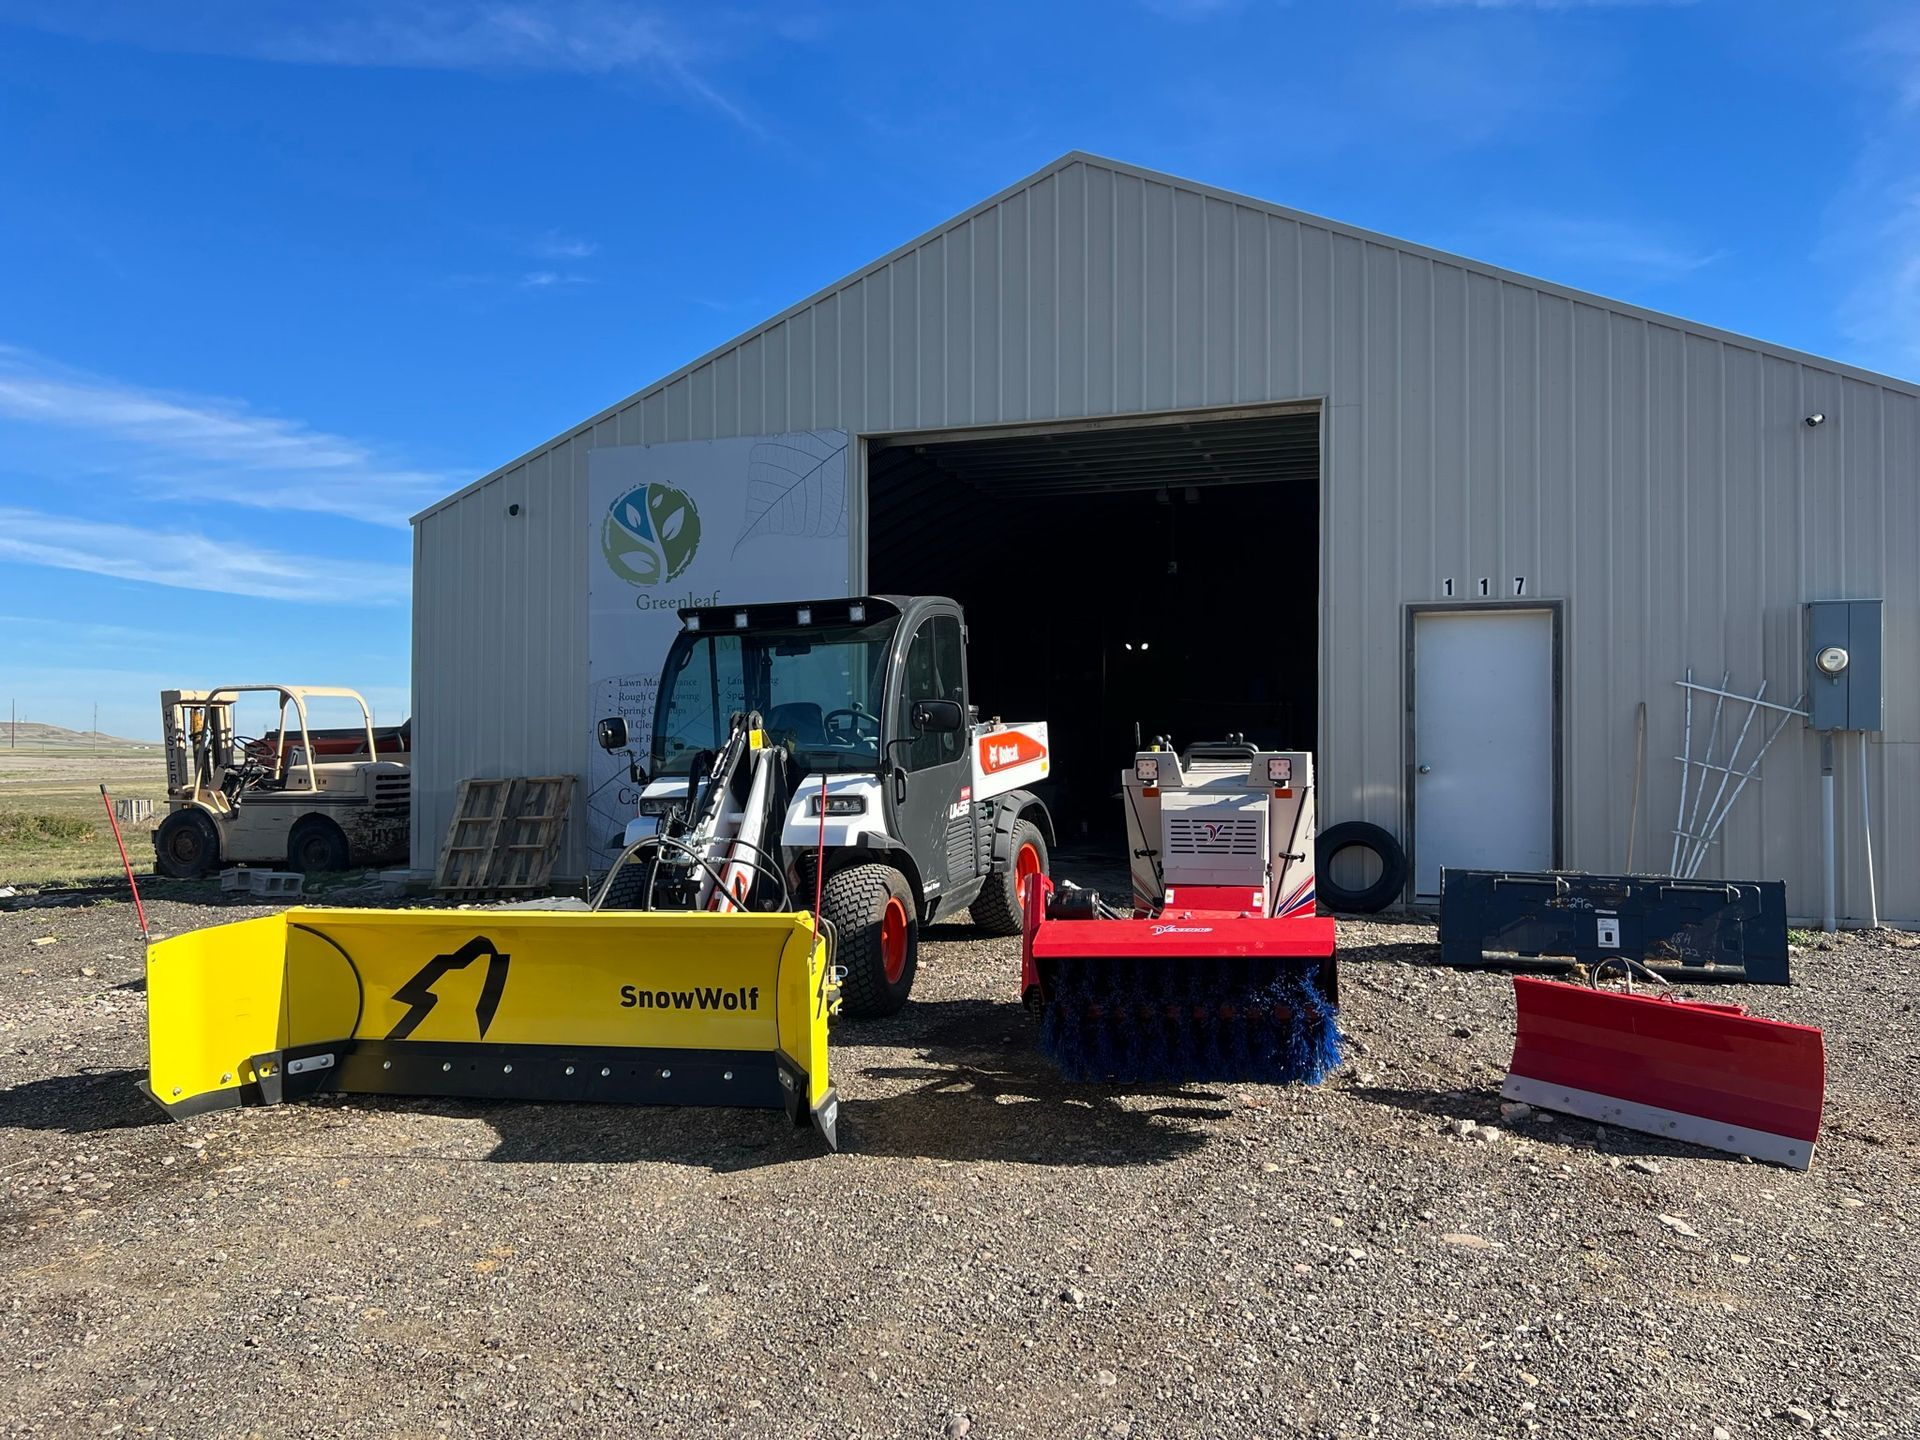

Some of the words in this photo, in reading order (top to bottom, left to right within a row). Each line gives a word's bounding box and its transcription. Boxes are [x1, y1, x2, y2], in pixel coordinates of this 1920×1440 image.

[636, 590, 721, 610] Greenleaf
[618, 678, 641, 687] Lawn
[618, 692, 646, 703] Rough
[617, 706, 646, 717] Spring
[165, 711, 178, 784] HYSTER
[619, 985, 760, 1011] SnowWolf
